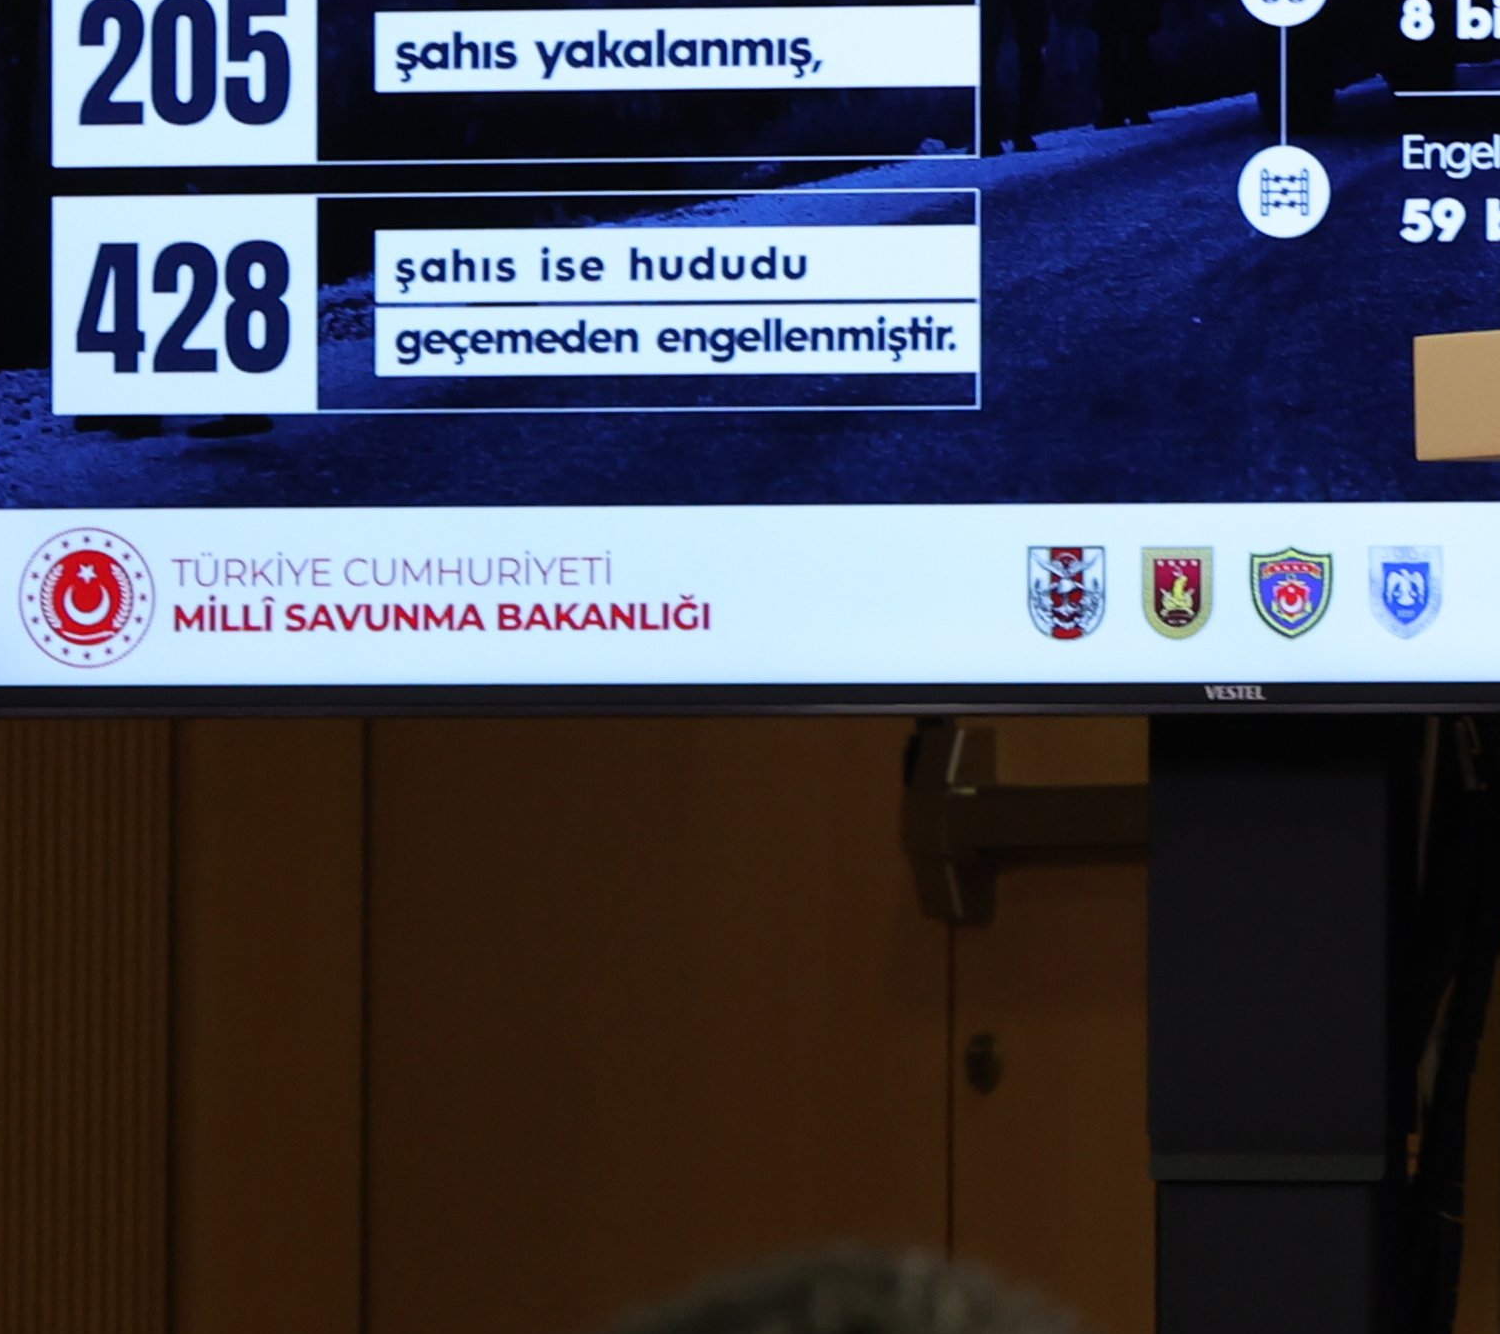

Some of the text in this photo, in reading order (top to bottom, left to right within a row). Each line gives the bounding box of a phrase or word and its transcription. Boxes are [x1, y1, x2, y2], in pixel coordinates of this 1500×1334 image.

[395, 28, 823, 83] şahıs yakalanmış,
[1399, 197, 1467, 243] 59
[395, 245, 807, 295] şahıs ise hududu
[75, 239, 291, 374] 428
[395, 315, 958, 366] geçemeden engellenmiştir.
[171, 550, 612, 588] TÜRKİYE CUMHURİYETİ
[173, 594, 711, 633] MİLLÎ SAVUNMA BAKANLIĞI
[1204, 683, 1267, 702] VESTEL
